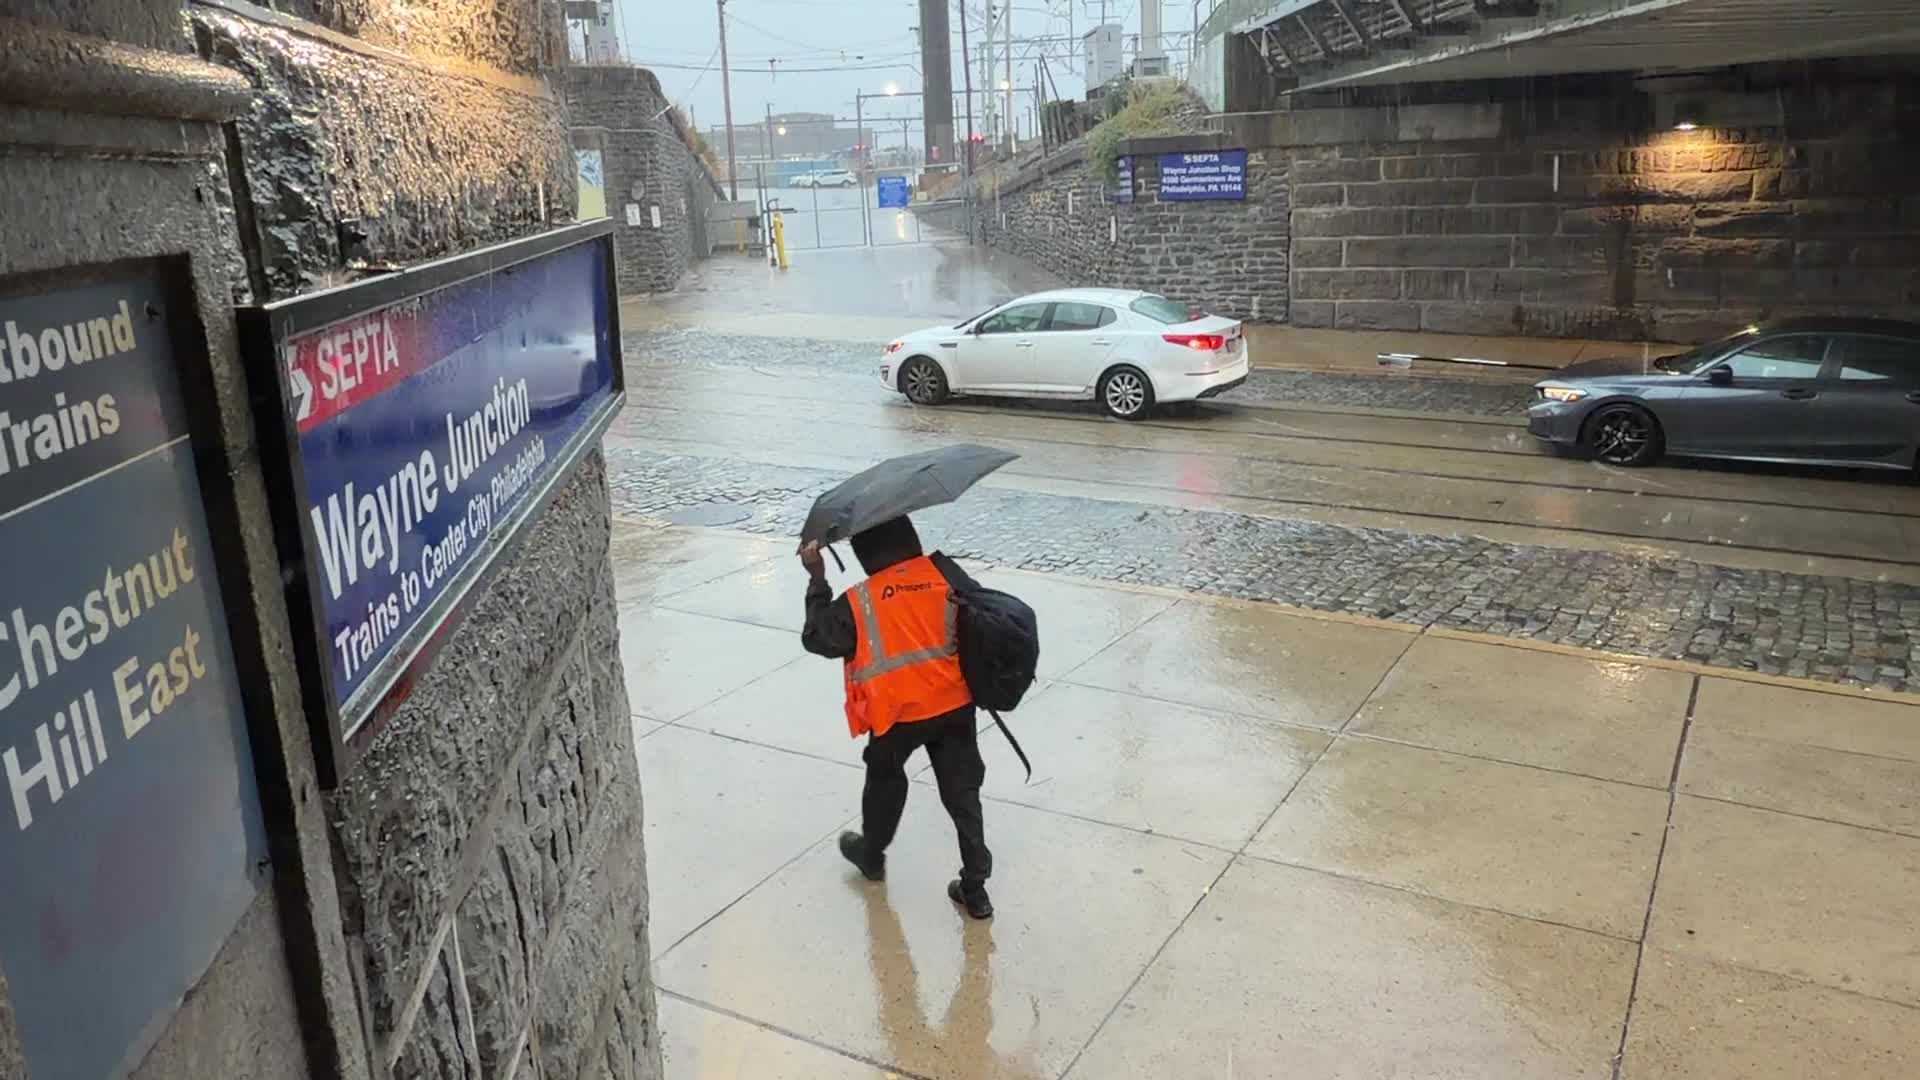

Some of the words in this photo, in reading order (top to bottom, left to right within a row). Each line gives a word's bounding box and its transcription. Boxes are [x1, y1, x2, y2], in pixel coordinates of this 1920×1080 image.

[1163, 167, 1187, 176] Wayne
[1188, 166, 1219, 174] Junction
[1221, 165, 1241, 174] Shop
[1180, 175, 1226, 184] Germantown
[1192, 154, 1219, 163] SEPTA
[1208, 184, 1219, 192] PA
[318, 319, 399, 400] SEPTA
[310, 449, 438, 600] Wayne
[444, 376, 530, 494] Junction
[335, 592, 400, 681] Trains
[401, 570, 420, 613] to
[421, 520, 466, 589] Center
[468, 493, 491, 538] City
[491, 434, 546, 513] Philadelphia
[2, 688, 108, 831] Hill
[112, 623, 206, 740] East
